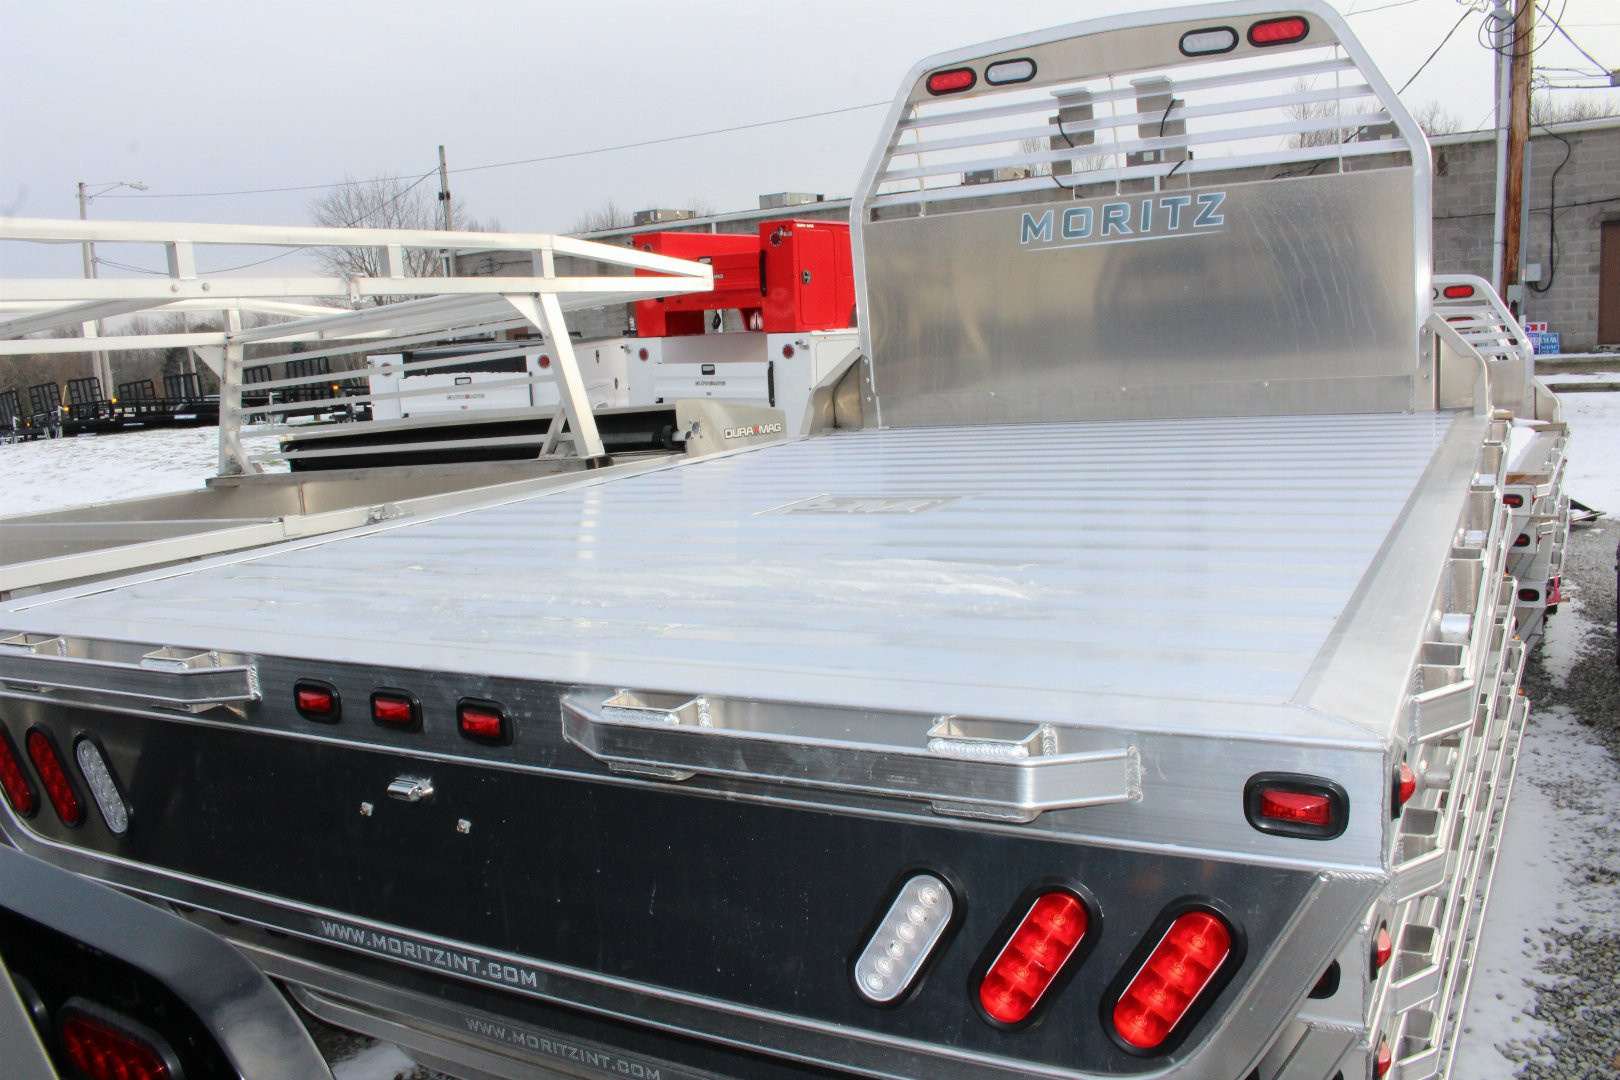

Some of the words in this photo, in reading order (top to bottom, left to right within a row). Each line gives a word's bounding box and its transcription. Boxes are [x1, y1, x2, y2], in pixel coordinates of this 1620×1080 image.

[1020, 191, 1227, 244] MORITZ
[321, 920, 537, 988] WWW.MORITZINT.COM
[466, 1017, 661, 1080] WWW.MORITZINT.COM
